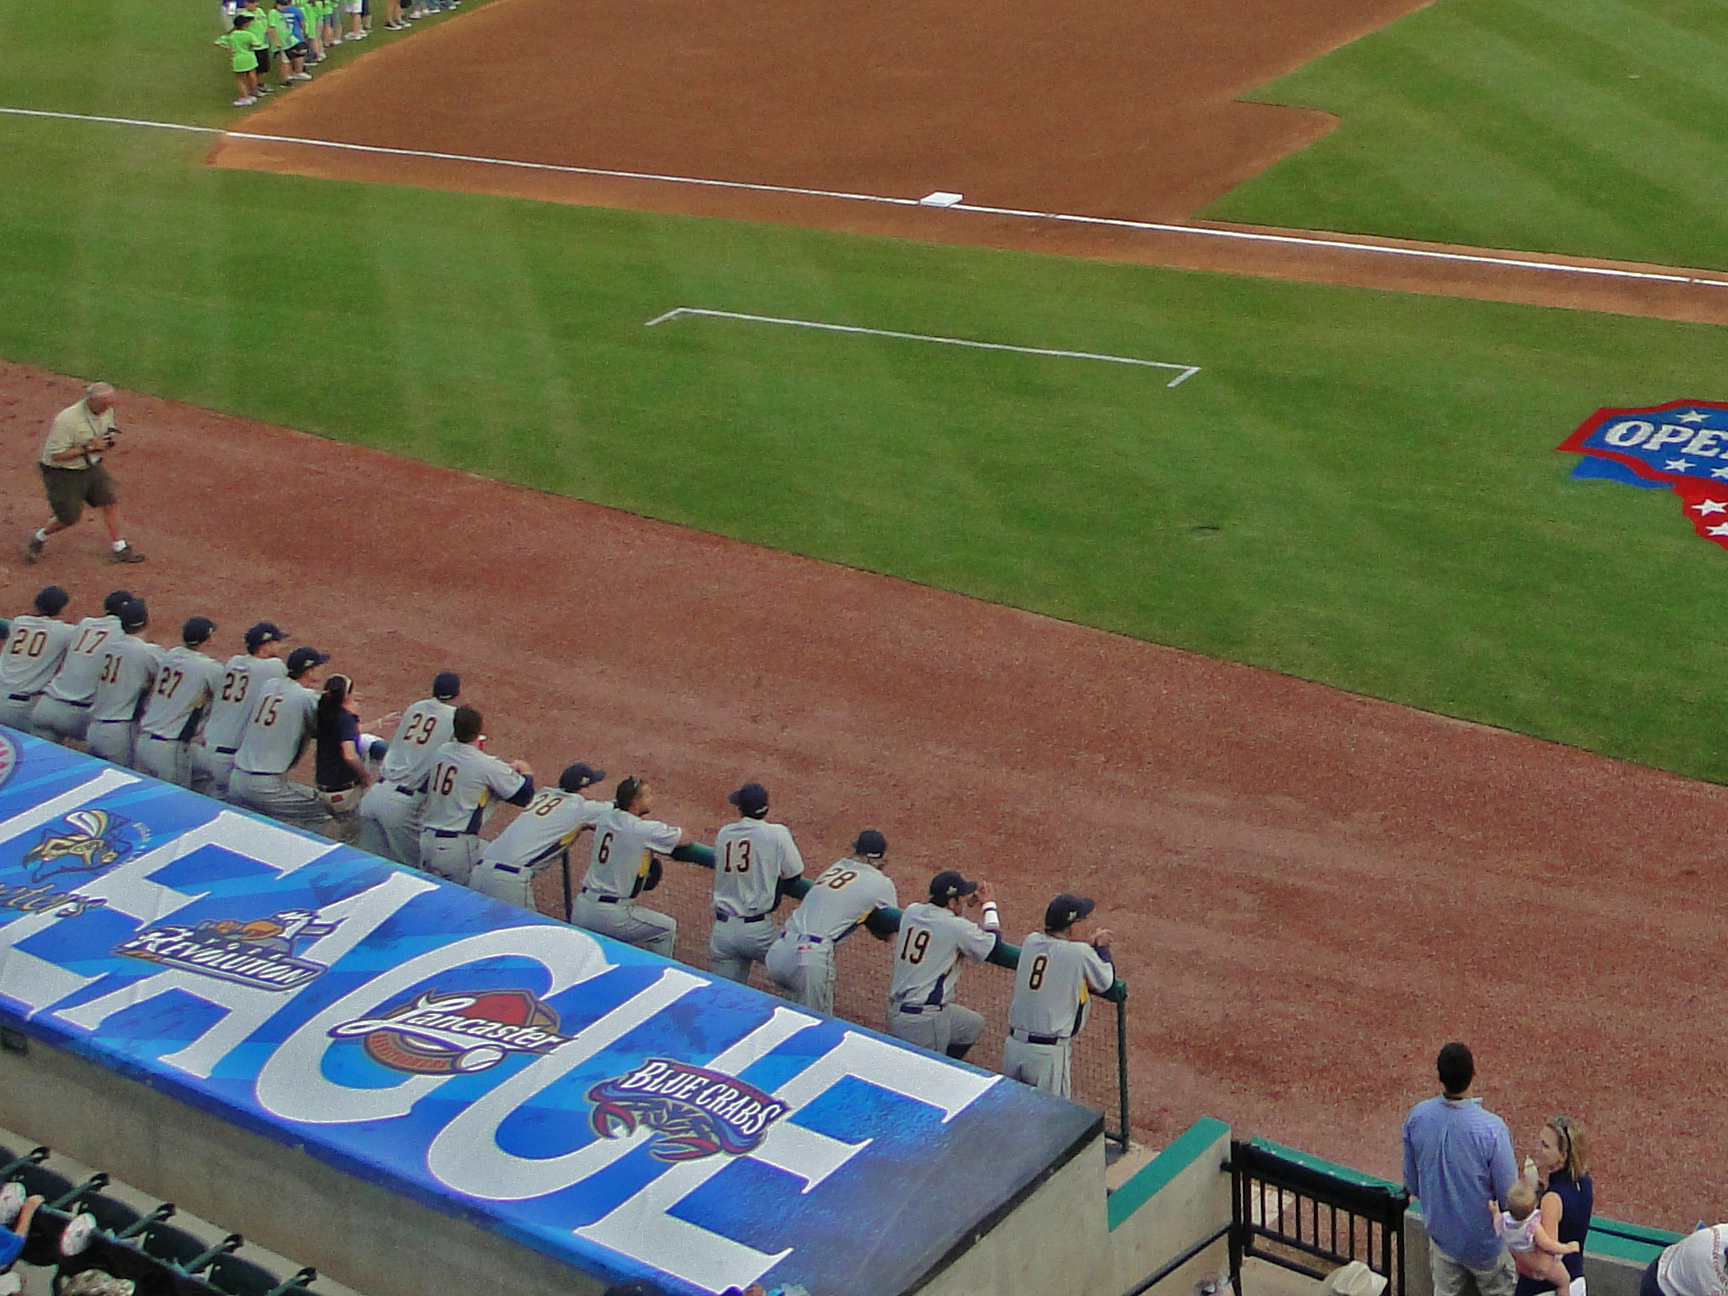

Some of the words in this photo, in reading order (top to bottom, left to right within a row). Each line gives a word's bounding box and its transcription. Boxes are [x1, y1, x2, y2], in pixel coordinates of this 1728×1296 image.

[11, 628, 46, 657] 20
[73, 629, 108, 655] 17
[100, 653, 119, 683] 31
[157, 665, 182, 699] 27
[222, 672, 250, 703] 23
[253, 694, 279, 727] 15
[403, 712, 437, 744] 29
[432, 761, 459, 795] 16
[598, 833, 613, 863] 6
[723, 840, 751, 873] 13
[814, 867, 857, 890] 28
[121, 927, 304, 984] REVOLUTION
[900, 927, 930, 965] 19
[1028, 956, 1049, 990] 8
[327, 987, 558, 1051] Lancaster
[622, 1061, 697, 1100] BLUE
[697, 1074, 784, 1135] CRABS
